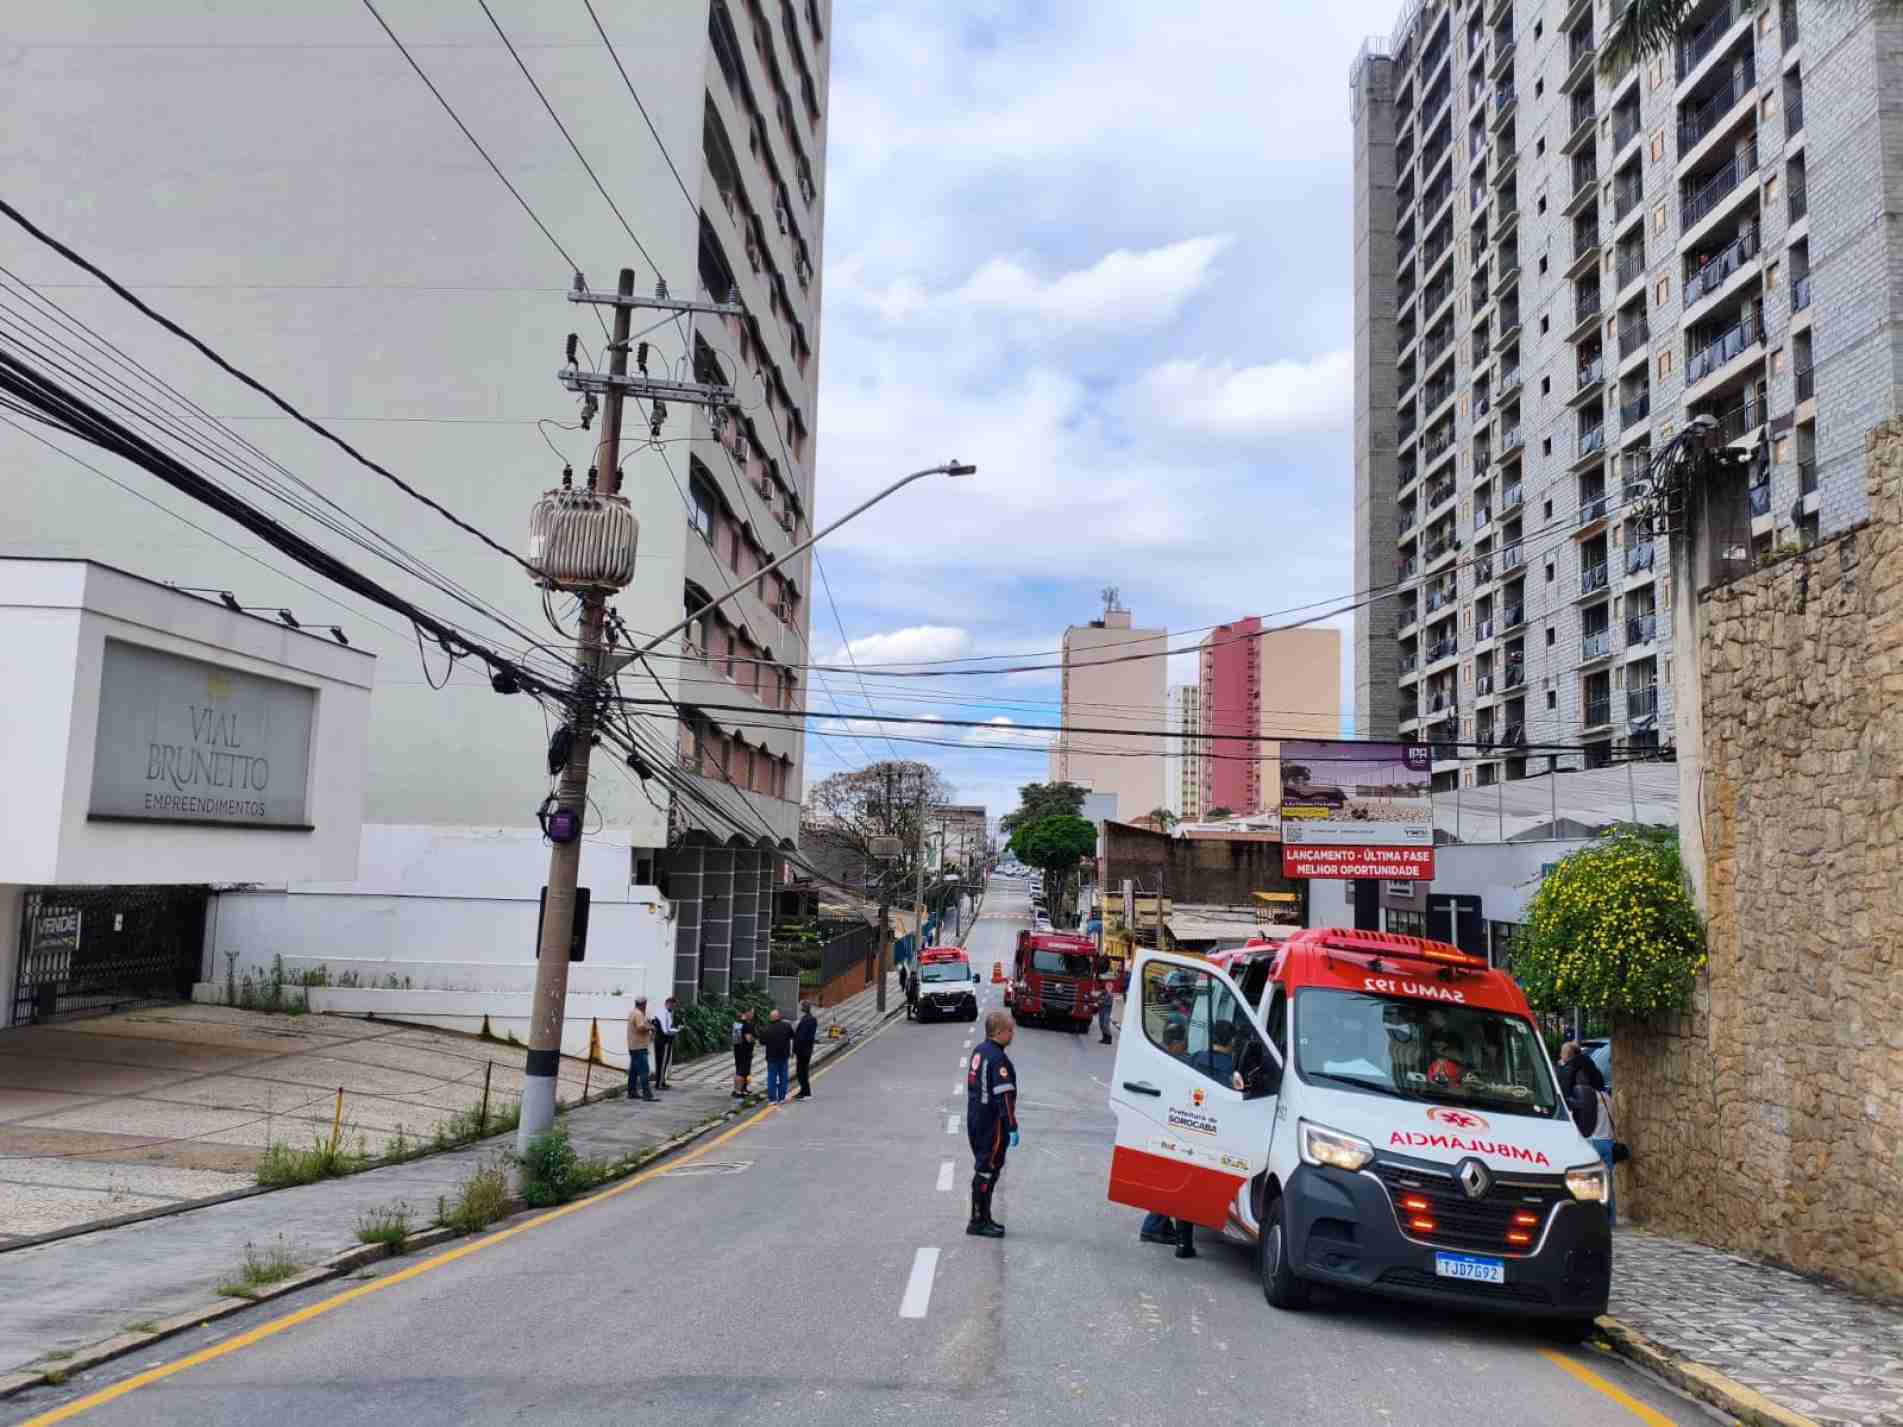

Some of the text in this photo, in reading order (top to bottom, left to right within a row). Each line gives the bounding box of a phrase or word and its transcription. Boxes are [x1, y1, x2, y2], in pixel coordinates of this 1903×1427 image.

[184, 704, 240, 748] VIAL
[145, 743, 269, 791] BRUNETTO
[144, 792, 265, 816] EMPREENDIMENTOS
[1286, 849, 1356, 863] LANÇAMENTO
[1363, 848, 1400, 862] ÚLTIMA
[1403, 851, 1430, 863] FASE
[1296, 863, 1420, 877] MELHOR OPORTUNIDADE
[1168, 1114, 1218, 1133] SOROCABA
